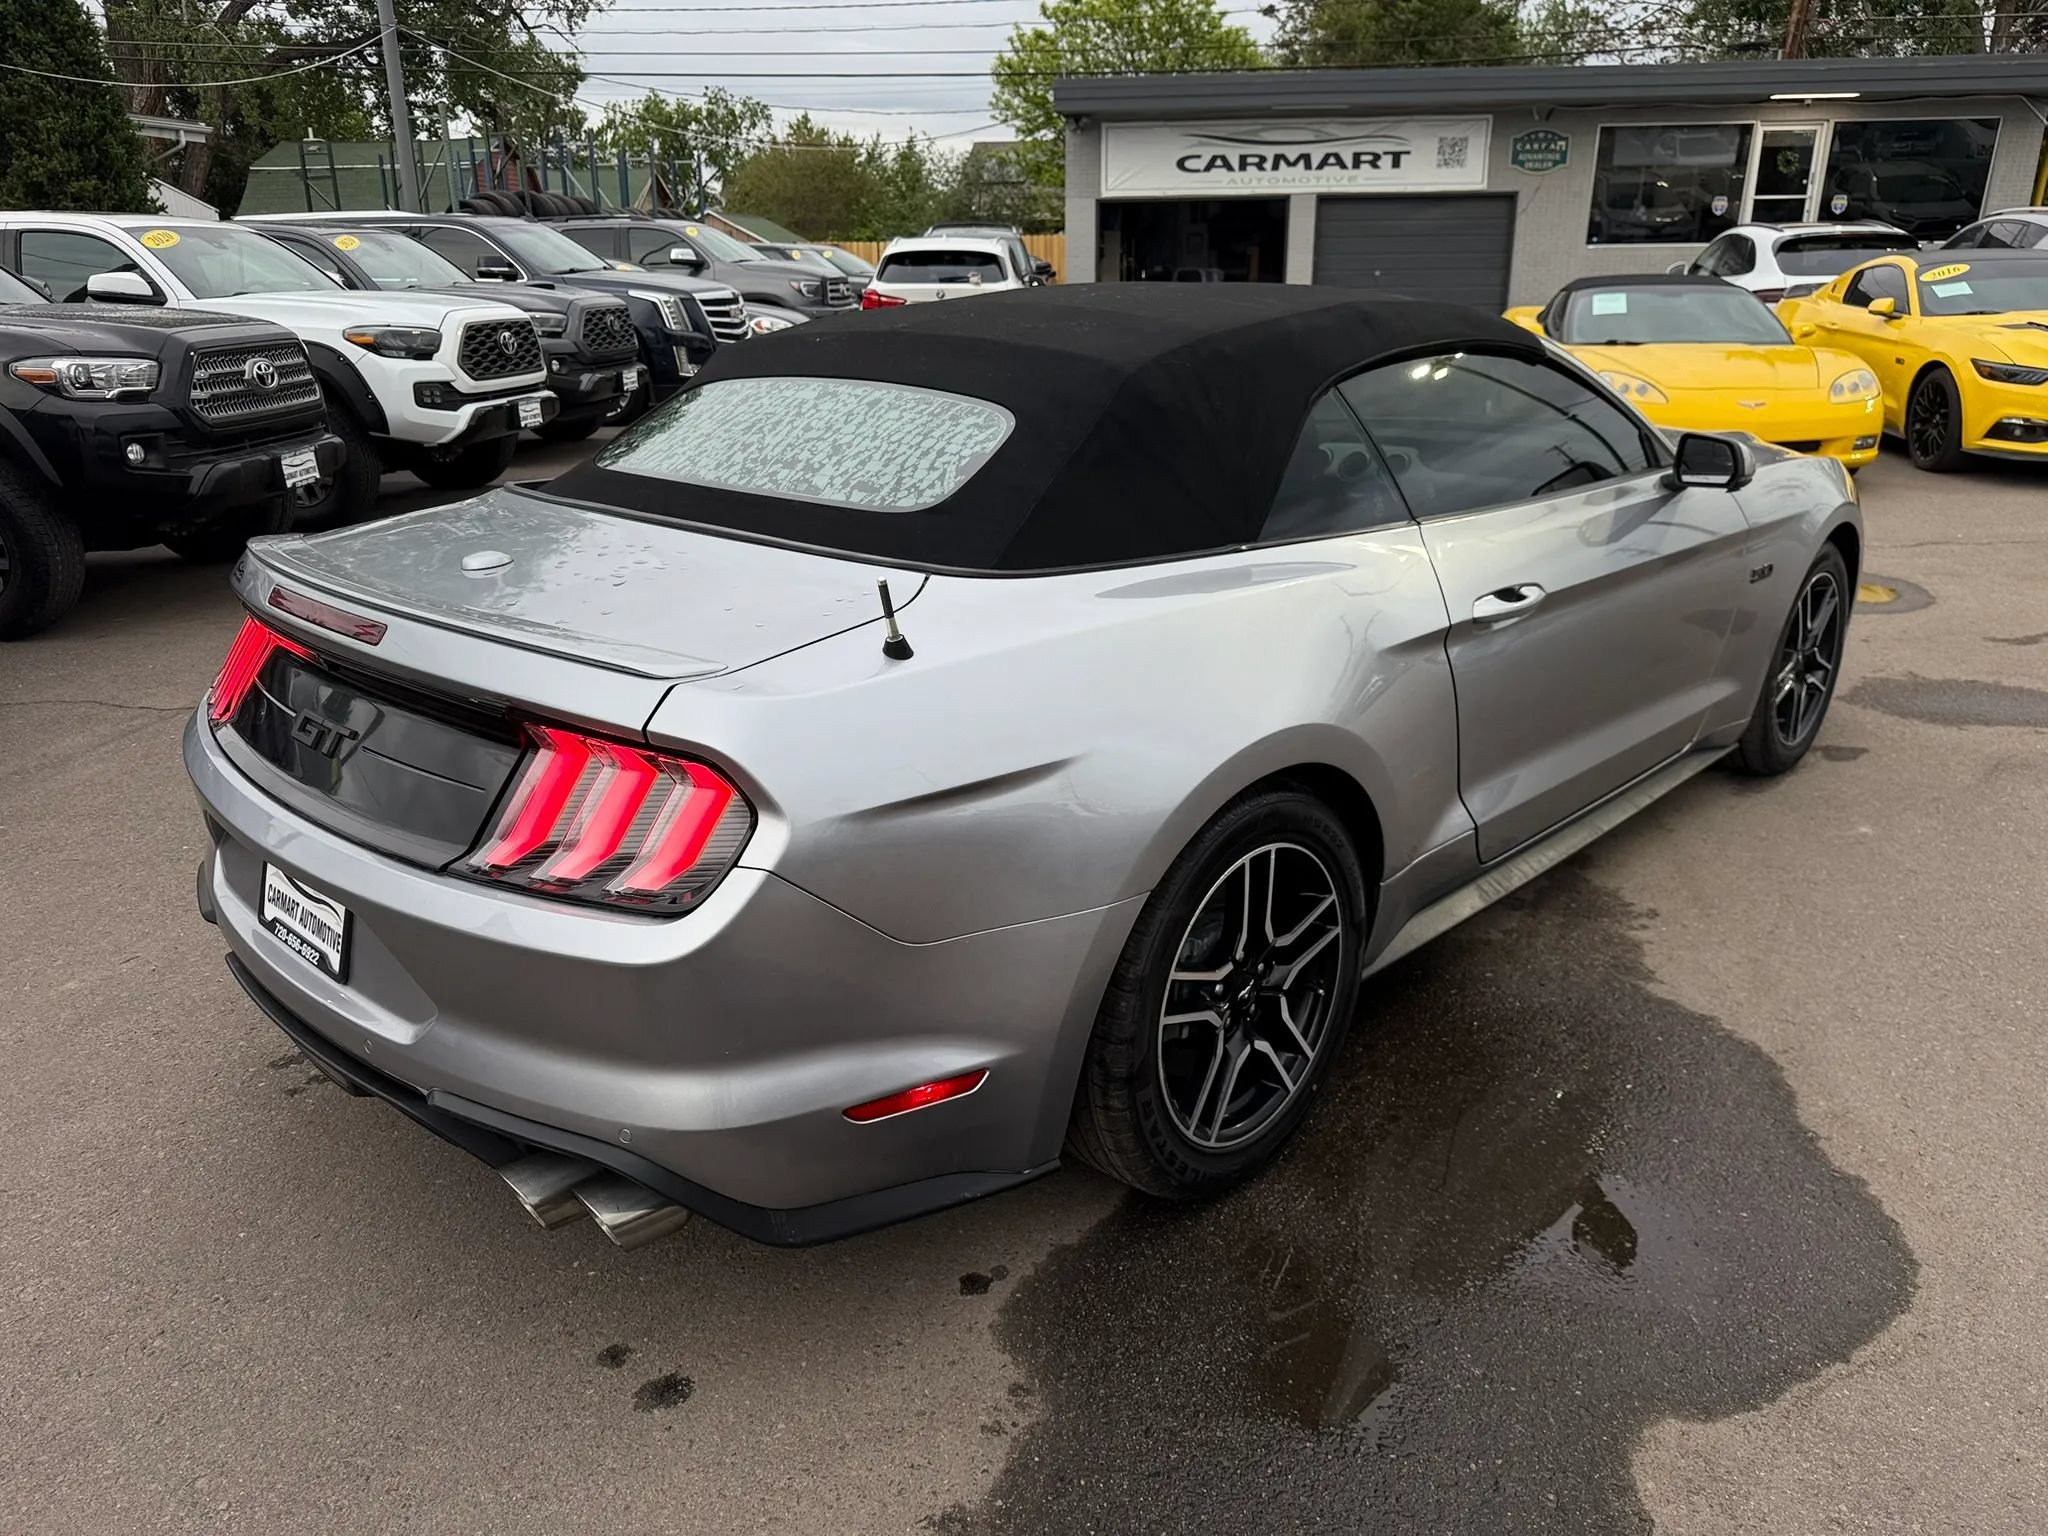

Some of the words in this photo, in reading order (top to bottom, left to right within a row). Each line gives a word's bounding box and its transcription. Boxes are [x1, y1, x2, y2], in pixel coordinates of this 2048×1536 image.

[1176, 151, 1411, 173] CARMART
[1225, 174, 1360, 187] AUTOMOTIVE
[147, 231, 175, 247] 2020
[290, 708, 361, 759] GT
[267, 883, 300, 922] CARMART
[298, 906, 342, 954] AUTOMOTIVE
[273, 923, 321, 966] 720-656-6922
